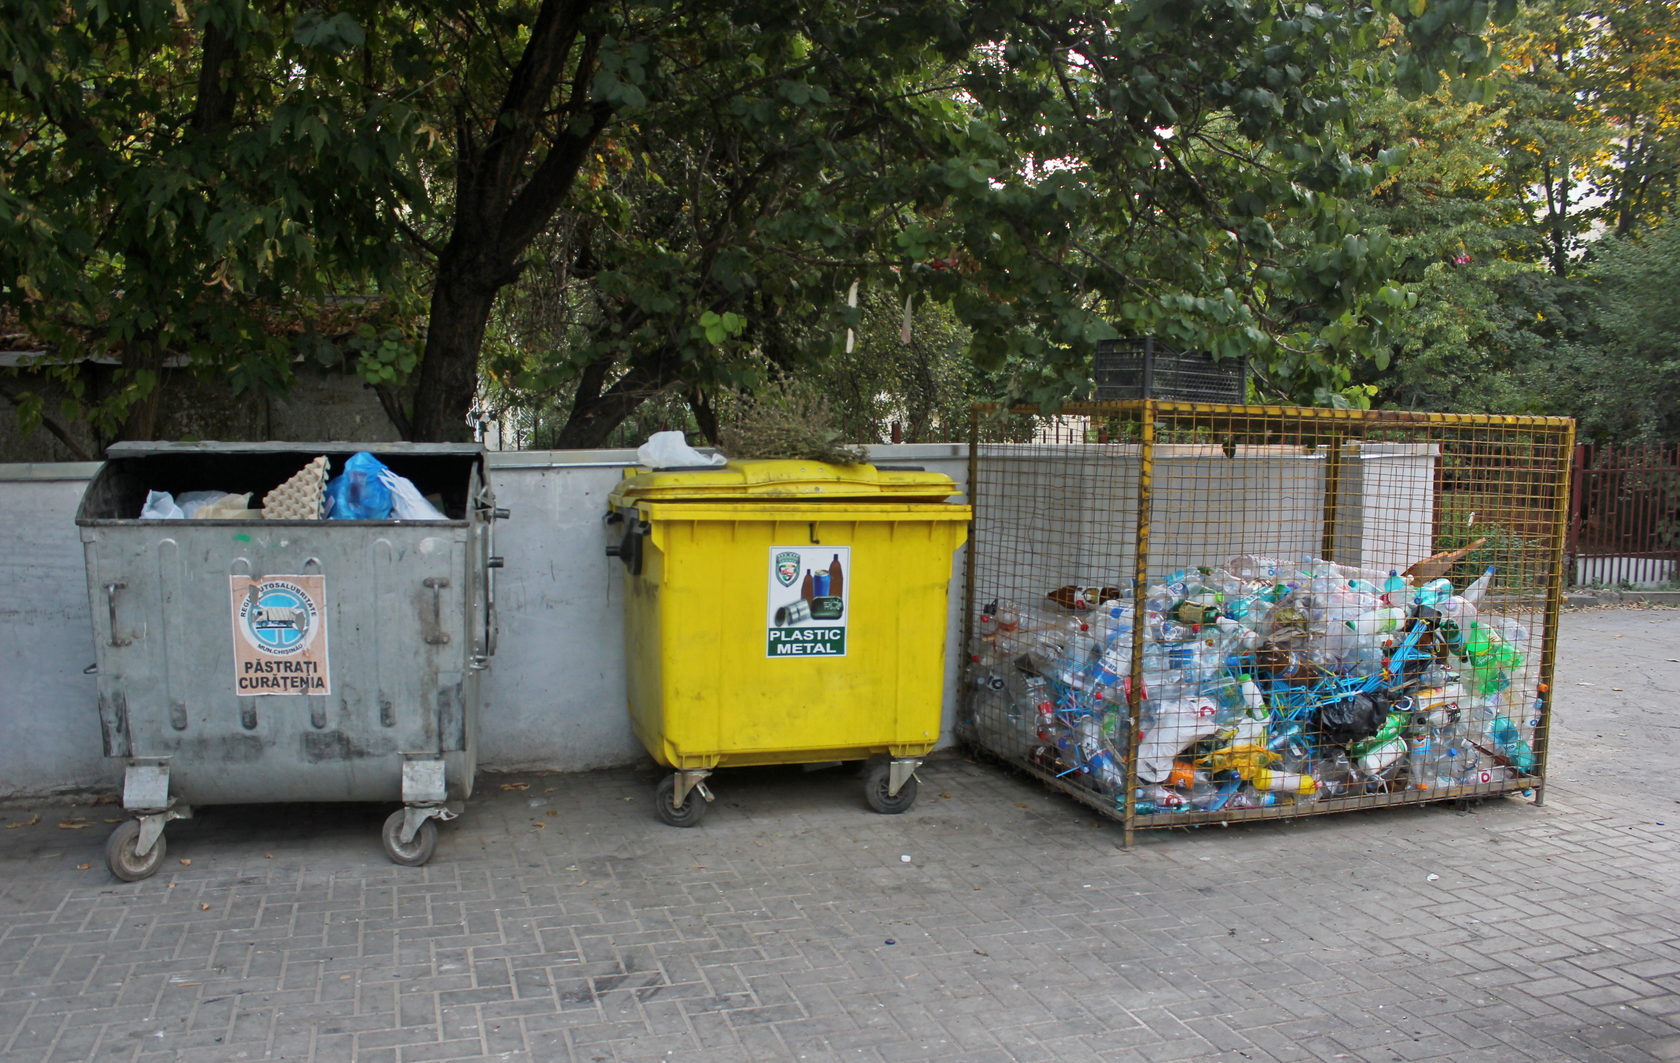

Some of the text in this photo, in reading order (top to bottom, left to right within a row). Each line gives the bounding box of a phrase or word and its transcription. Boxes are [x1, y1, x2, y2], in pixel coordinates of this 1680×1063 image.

[259, 583, 316, 616] UTOSALUBRITATE
[770, 629, 841, 641] PLASTIC
[777, 643, 837, 654] METAL
